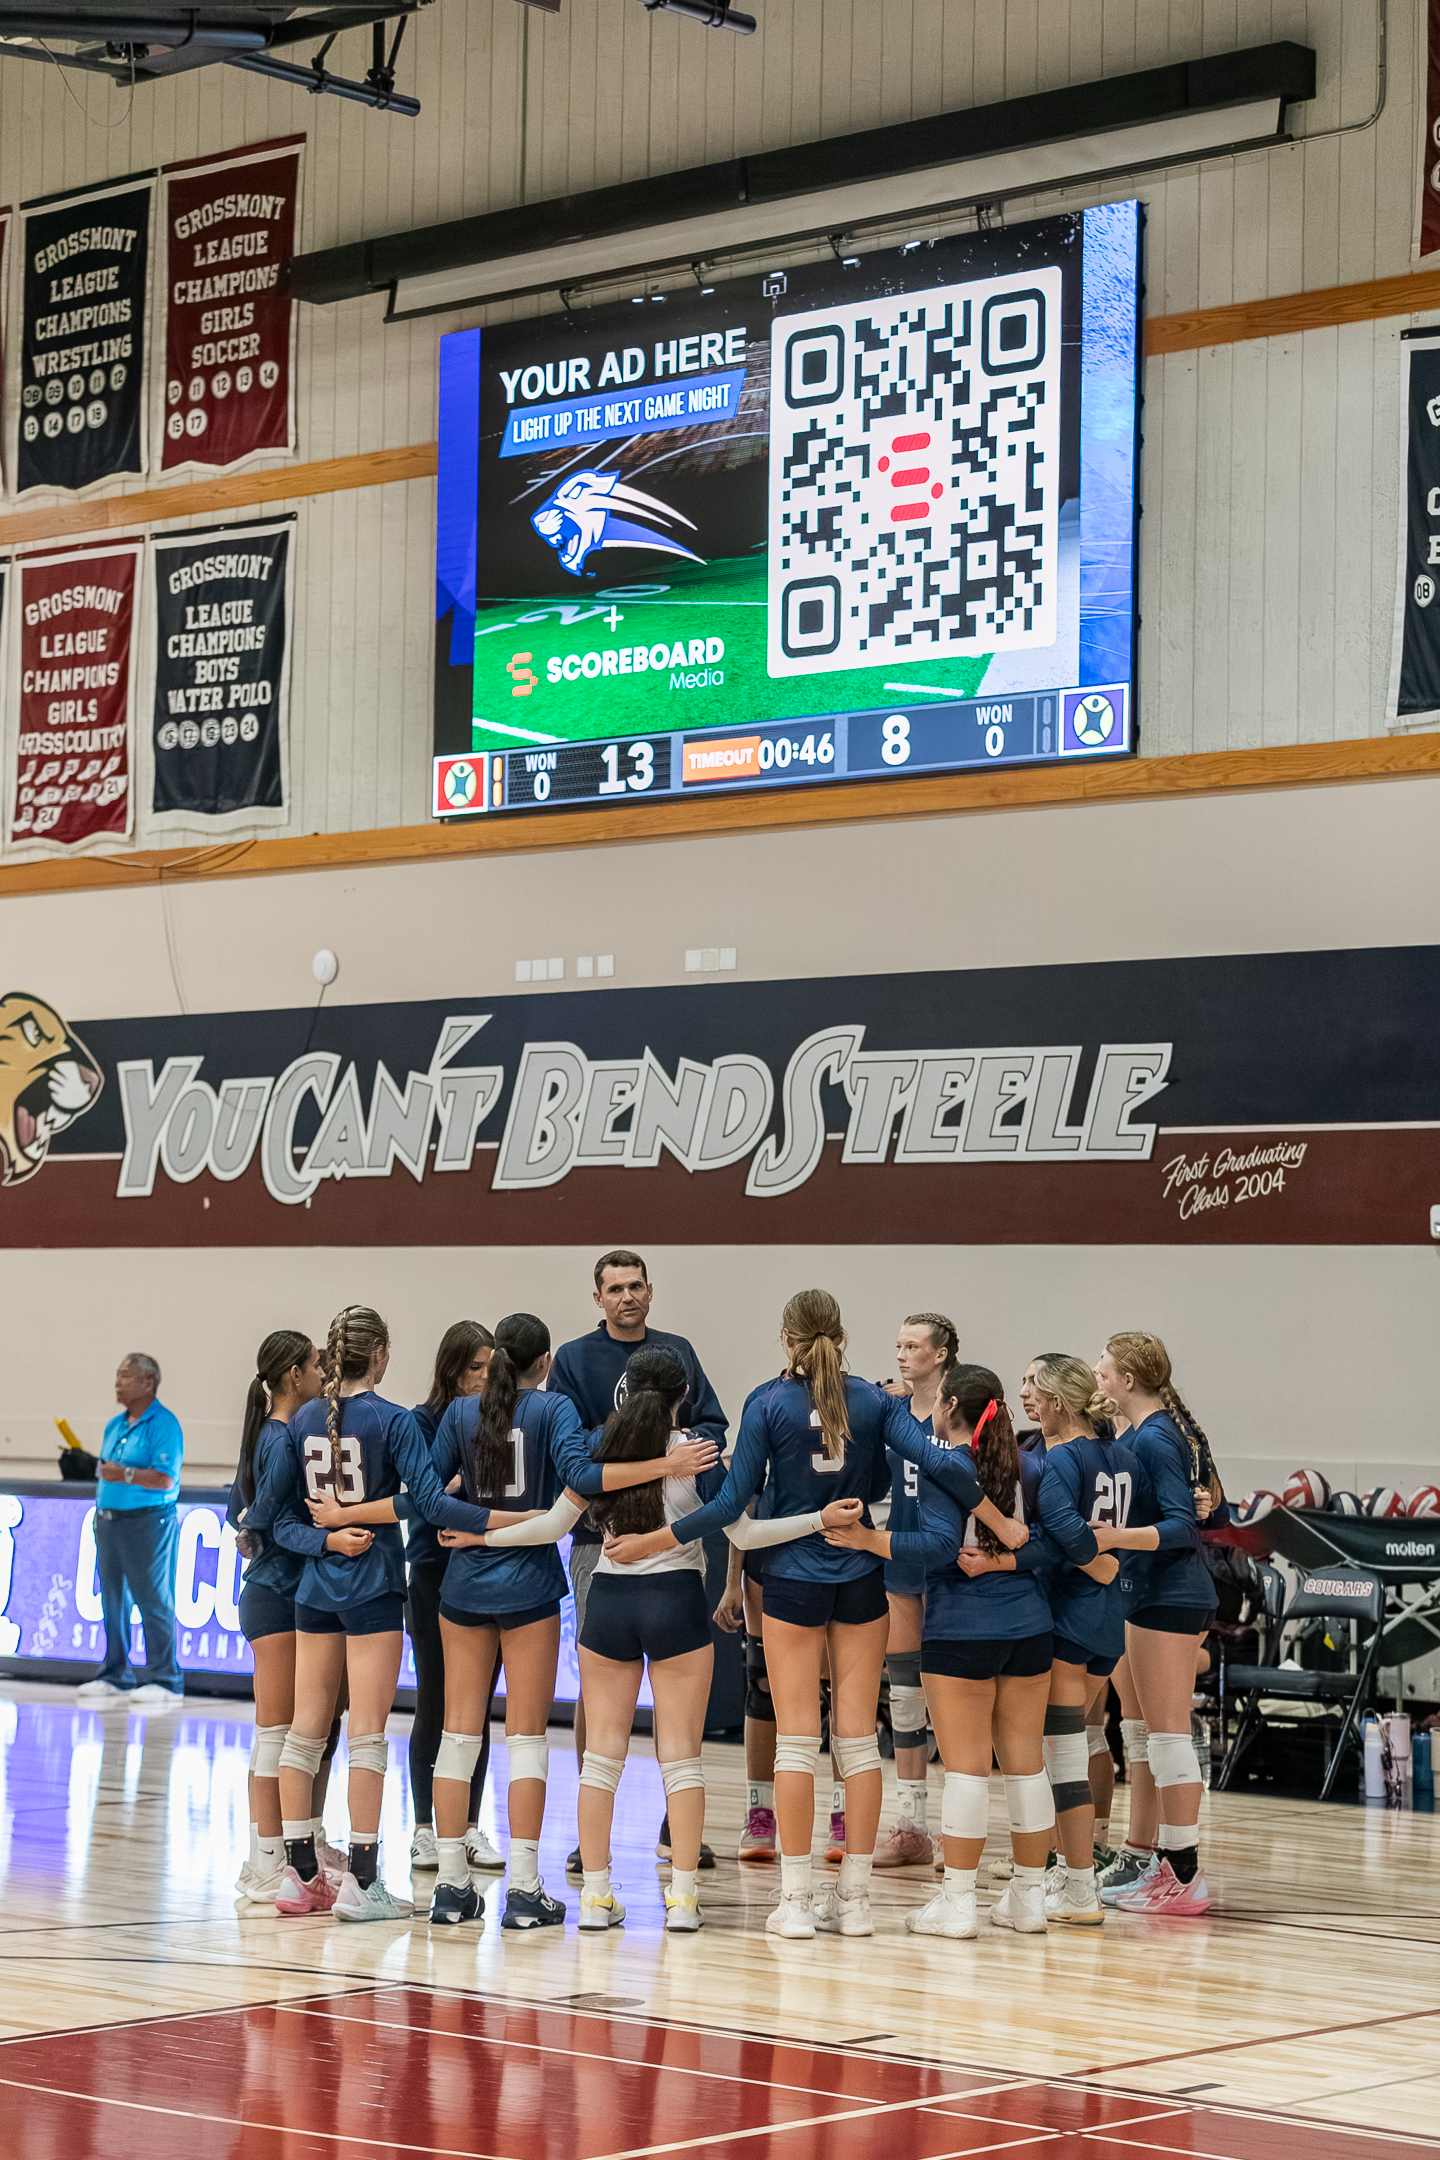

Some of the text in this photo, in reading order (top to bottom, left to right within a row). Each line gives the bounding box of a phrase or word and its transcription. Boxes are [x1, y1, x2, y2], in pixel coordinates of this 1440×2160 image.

[174, 194, 286, 239] GROSSMONT
[34, 226, 137, 274] GROSSMONT
[193, 230, 269, 267] LEAGUE
[49, 266, 120, 303] LEAGUE
[173, 263, 280, 304] CHAMPIONS
[35, 298, 132, 341] CHAMPIONS
[200, 302, 255, 335] GIRLS
[32, 334, 133, 378] WRESTLING
[191, 333, 260, 369] SOCCER
[499, 327, 747, 404] YOUR AD HERE
[113, 369, 124, 385] 12
[216, 377, 229, 393] 12
[263, 366, 275, 383] 14
[71, 412, 82, 428] 17
[190, 415, 203, 430] 17
[513, 383, 731, 443] LIGHT UP THE NEXT GAME NIGHT
[168, 554, 273, 595] GROSSMONT
[1417, 582, 1430, 601] 08
[185, 600, 254, 630] LEAGUE
[40, 629, 108, 659] LEAGUE
[167, 625, 266, 659] CHAMPIONS
[547, 637, 725, 683] SCOREBOARD
[23, 663, 120, 694] CHAMPIONS
[194, 656, 241, 685] BOYS
[669, 668, 724, 691] Media
[47, 698, 98, 725] GIRLS
[227, 680, 272, 709] POLO
[976, 704, 1013, 726] WON
[688, 732, 835, 771] TIMEOUT 00:46
[881, 714, 911, 766] 8
[984, 725, 1005, 757] 0
[525, 752, 558, 772] WON
[598, 741, 655, 795] 13
[533, 771, 550, 801] 0
[492, 1042, 774, 1190] BEND
[745, 1025, 1173, 1196] STEELE
[1161, 1141, 1308, 1198] First Graduating
[1179, 1167, 1287, 1220] Class 2004
[809, 1409, 845, 1473] 3
[304, 1435, 365, 1503] 23
[1091, 1471, 1133, 1530] 20
[1385, 1541, 1436, 1556] molten
[1304, 1578, 1374, 1598] COUGARS
